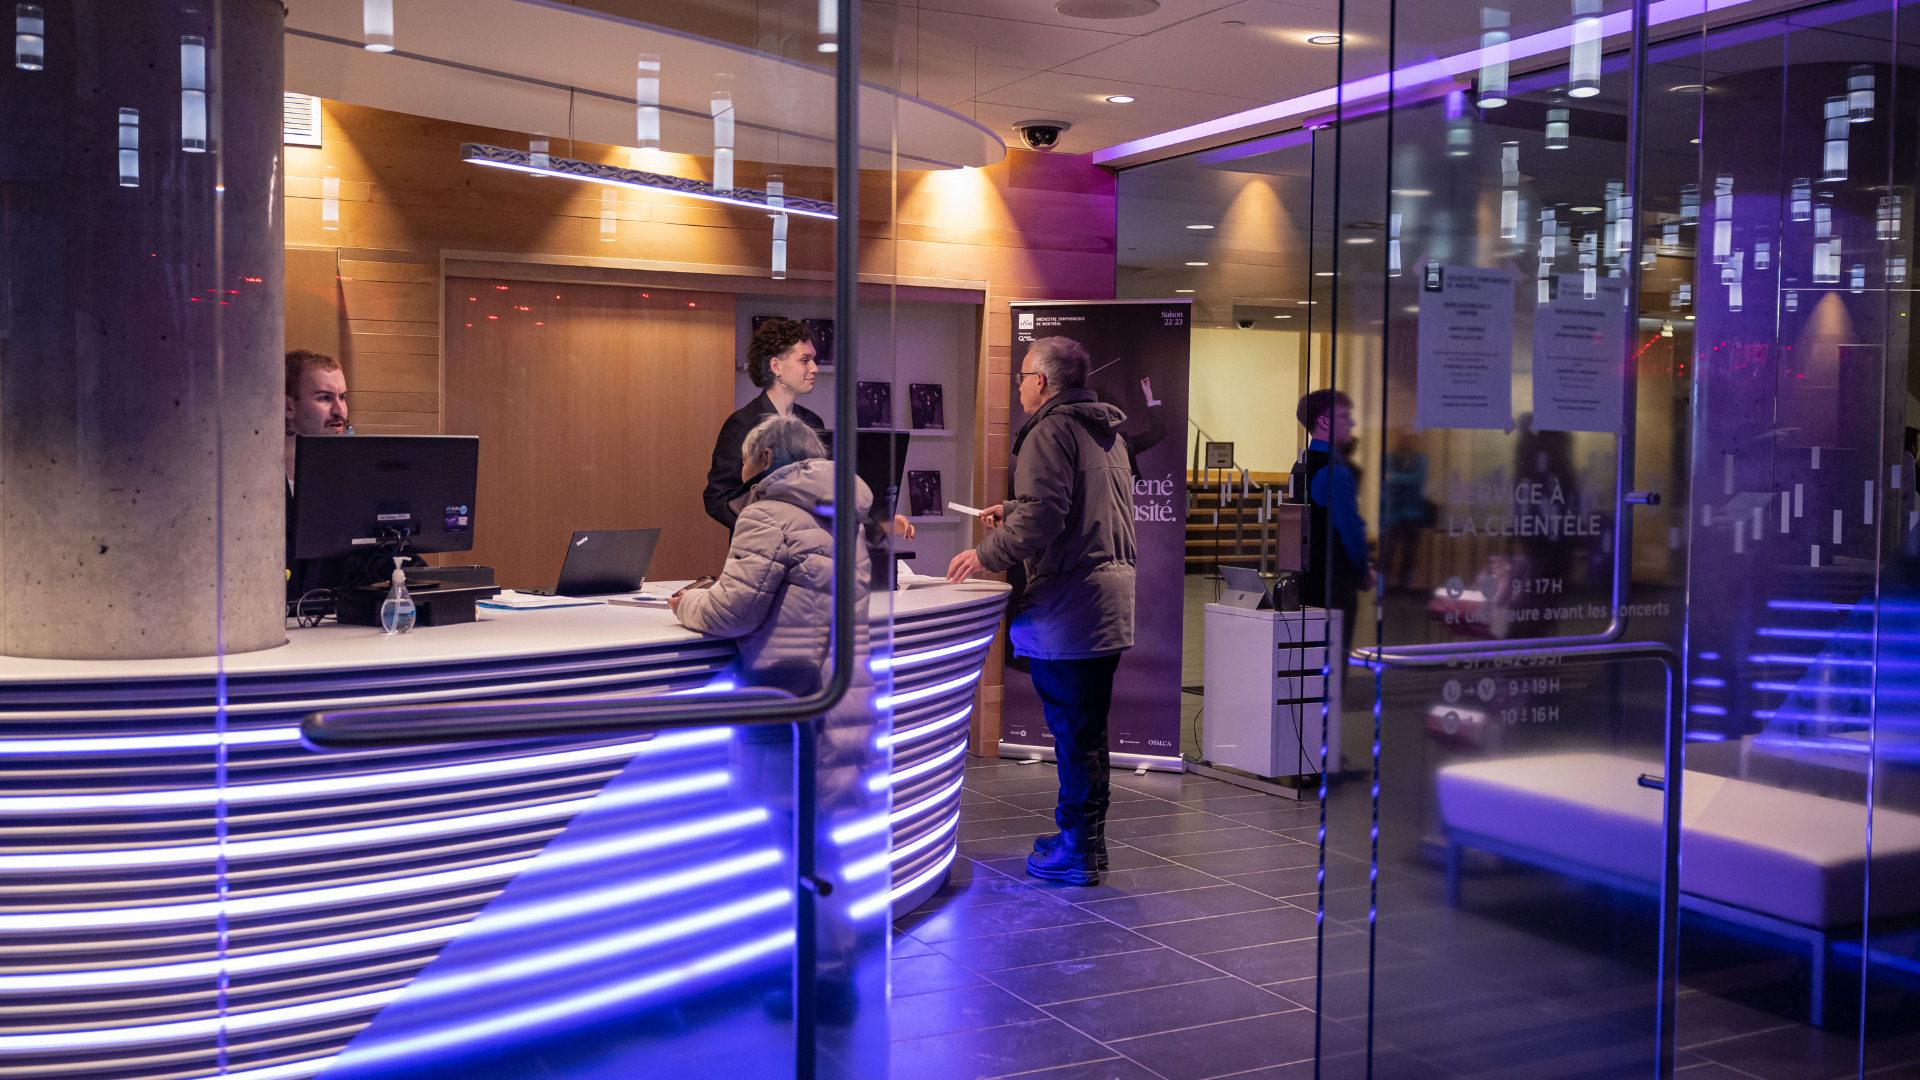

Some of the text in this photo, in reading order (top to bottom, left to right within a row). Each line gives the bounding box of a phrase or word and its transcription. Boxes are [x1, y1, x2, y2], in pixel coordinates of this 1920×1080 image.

[1161, 310, 1183, 318] Saison
[1449, 483, 1543, 505] SERVICE
[1448, 510, 1602, 537] LA CLIENTÈLE
[1544, 604, 1583, 620] avant
[1588, 603, 1607, 618] les
